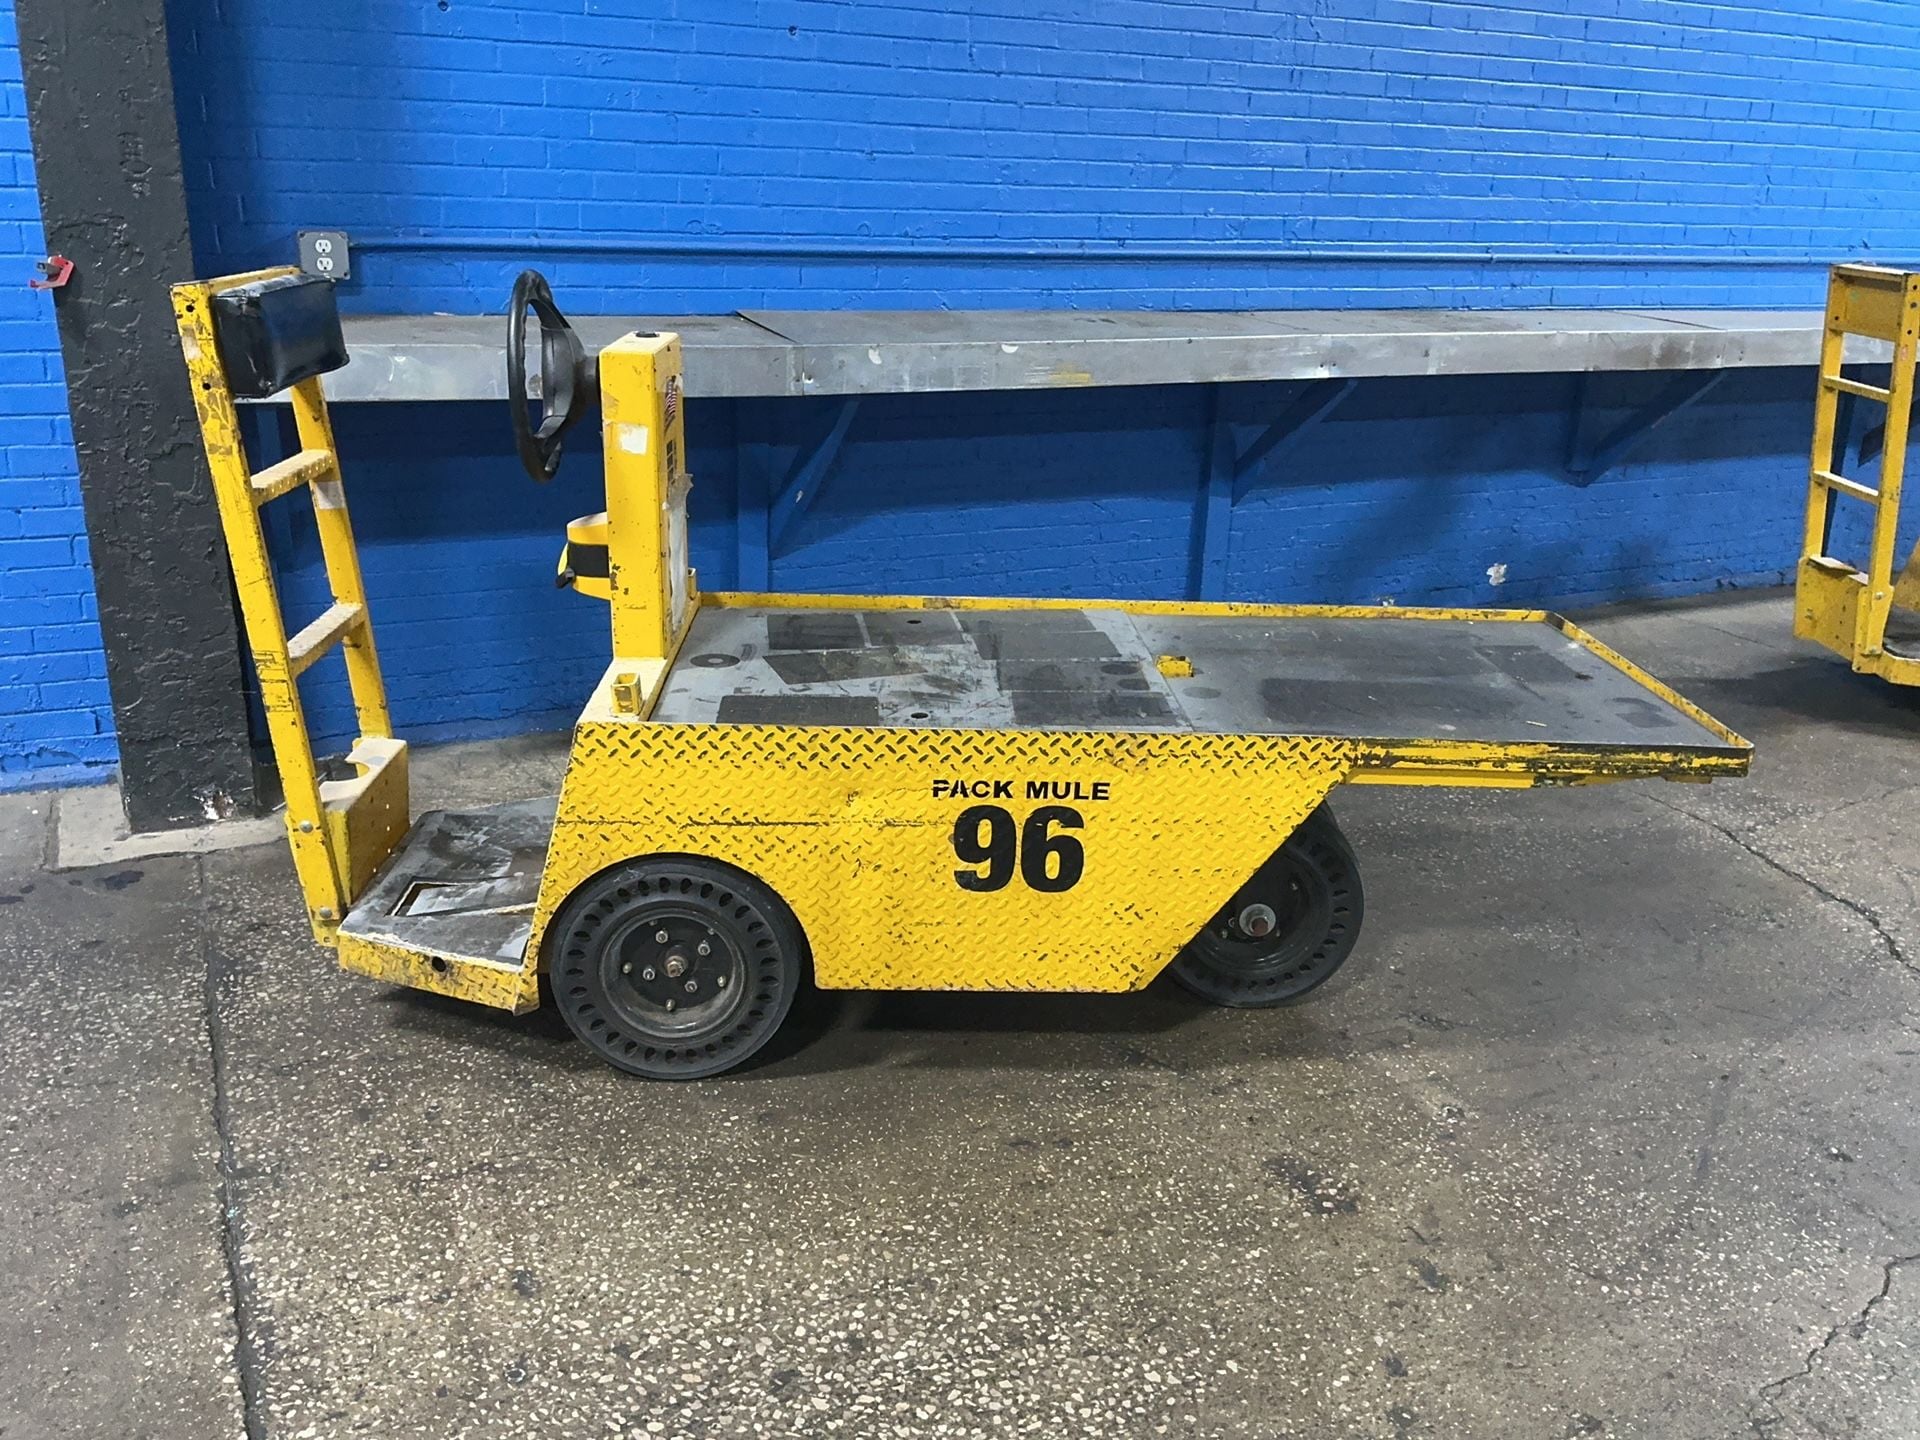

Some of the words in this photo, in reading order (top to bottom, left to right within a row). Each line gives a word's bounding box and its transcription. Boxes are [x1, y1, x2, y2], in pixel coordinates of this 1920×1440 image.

[932, 780, 1014, 799] PACK
[1026, 781, 1110, 800] MULE
[953, 804, 1084, 892] 96
